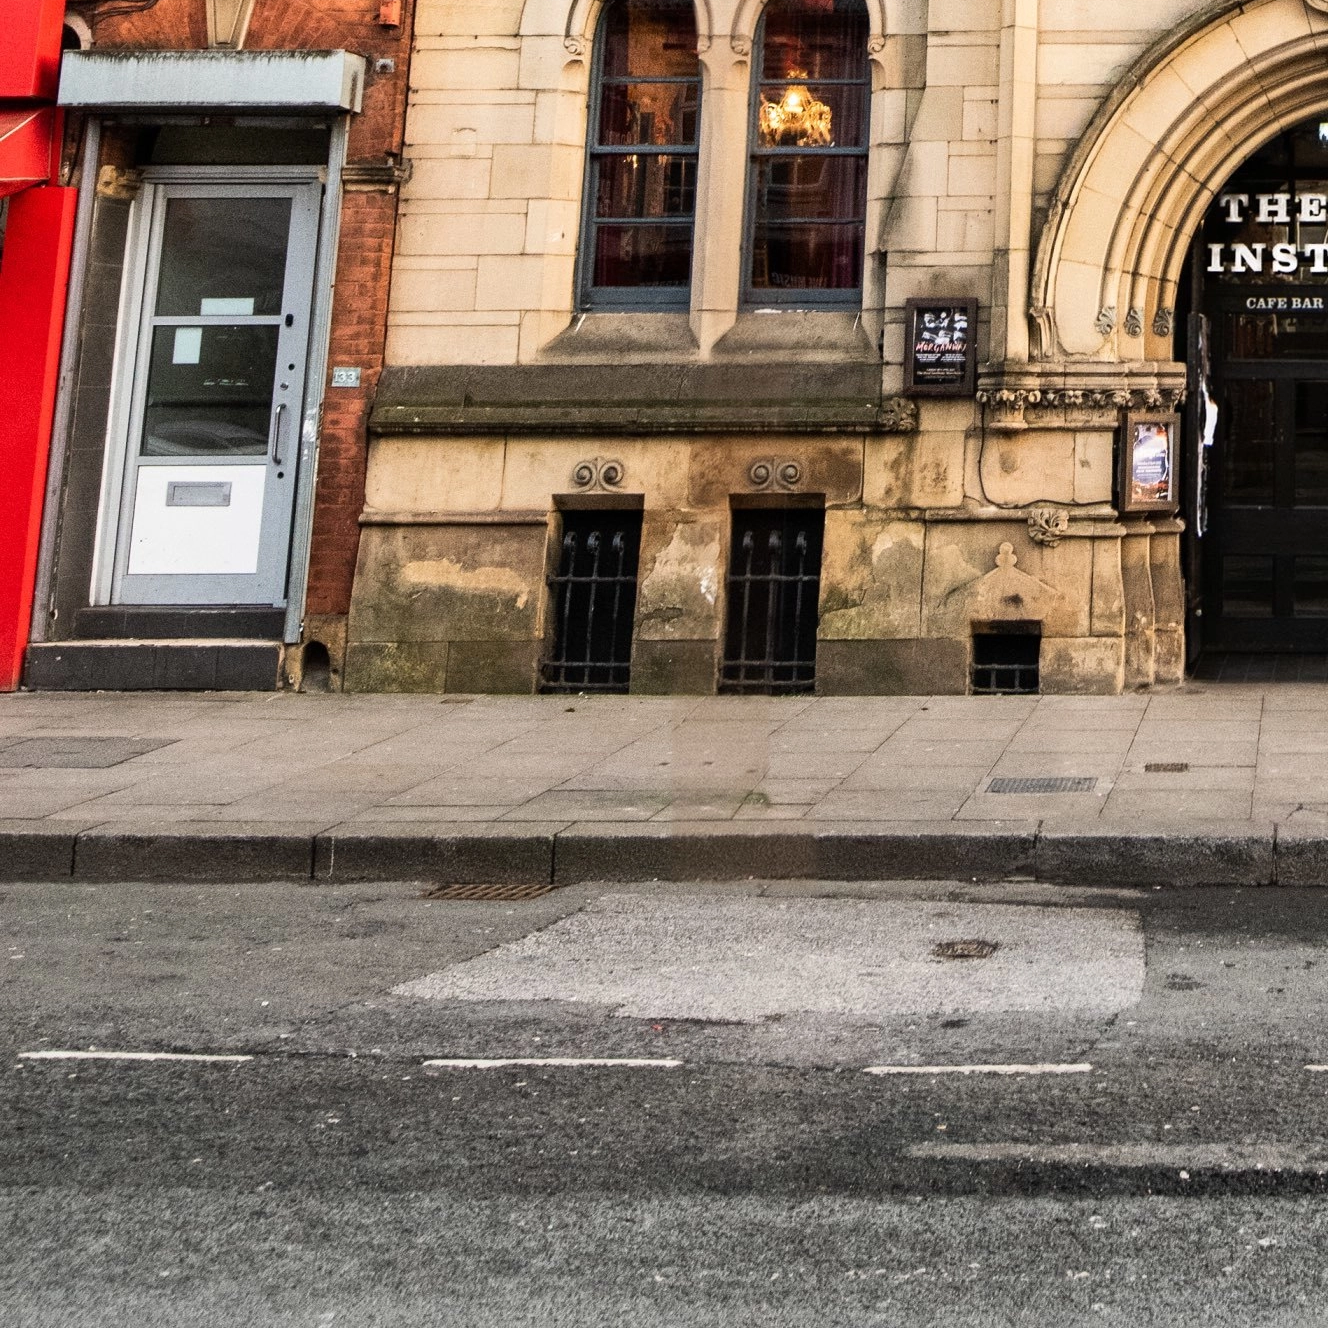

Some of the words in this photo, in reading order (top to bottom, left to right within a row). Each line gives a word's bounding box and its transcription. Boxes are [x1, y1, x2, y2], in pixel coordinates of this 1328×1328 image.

[1219, 195, 1328, 223] THE
[1246, 297, 1288, 309] CAFE
[1291, 297, 1324, 309] BAR
[335, 371, 356, 383] 133
